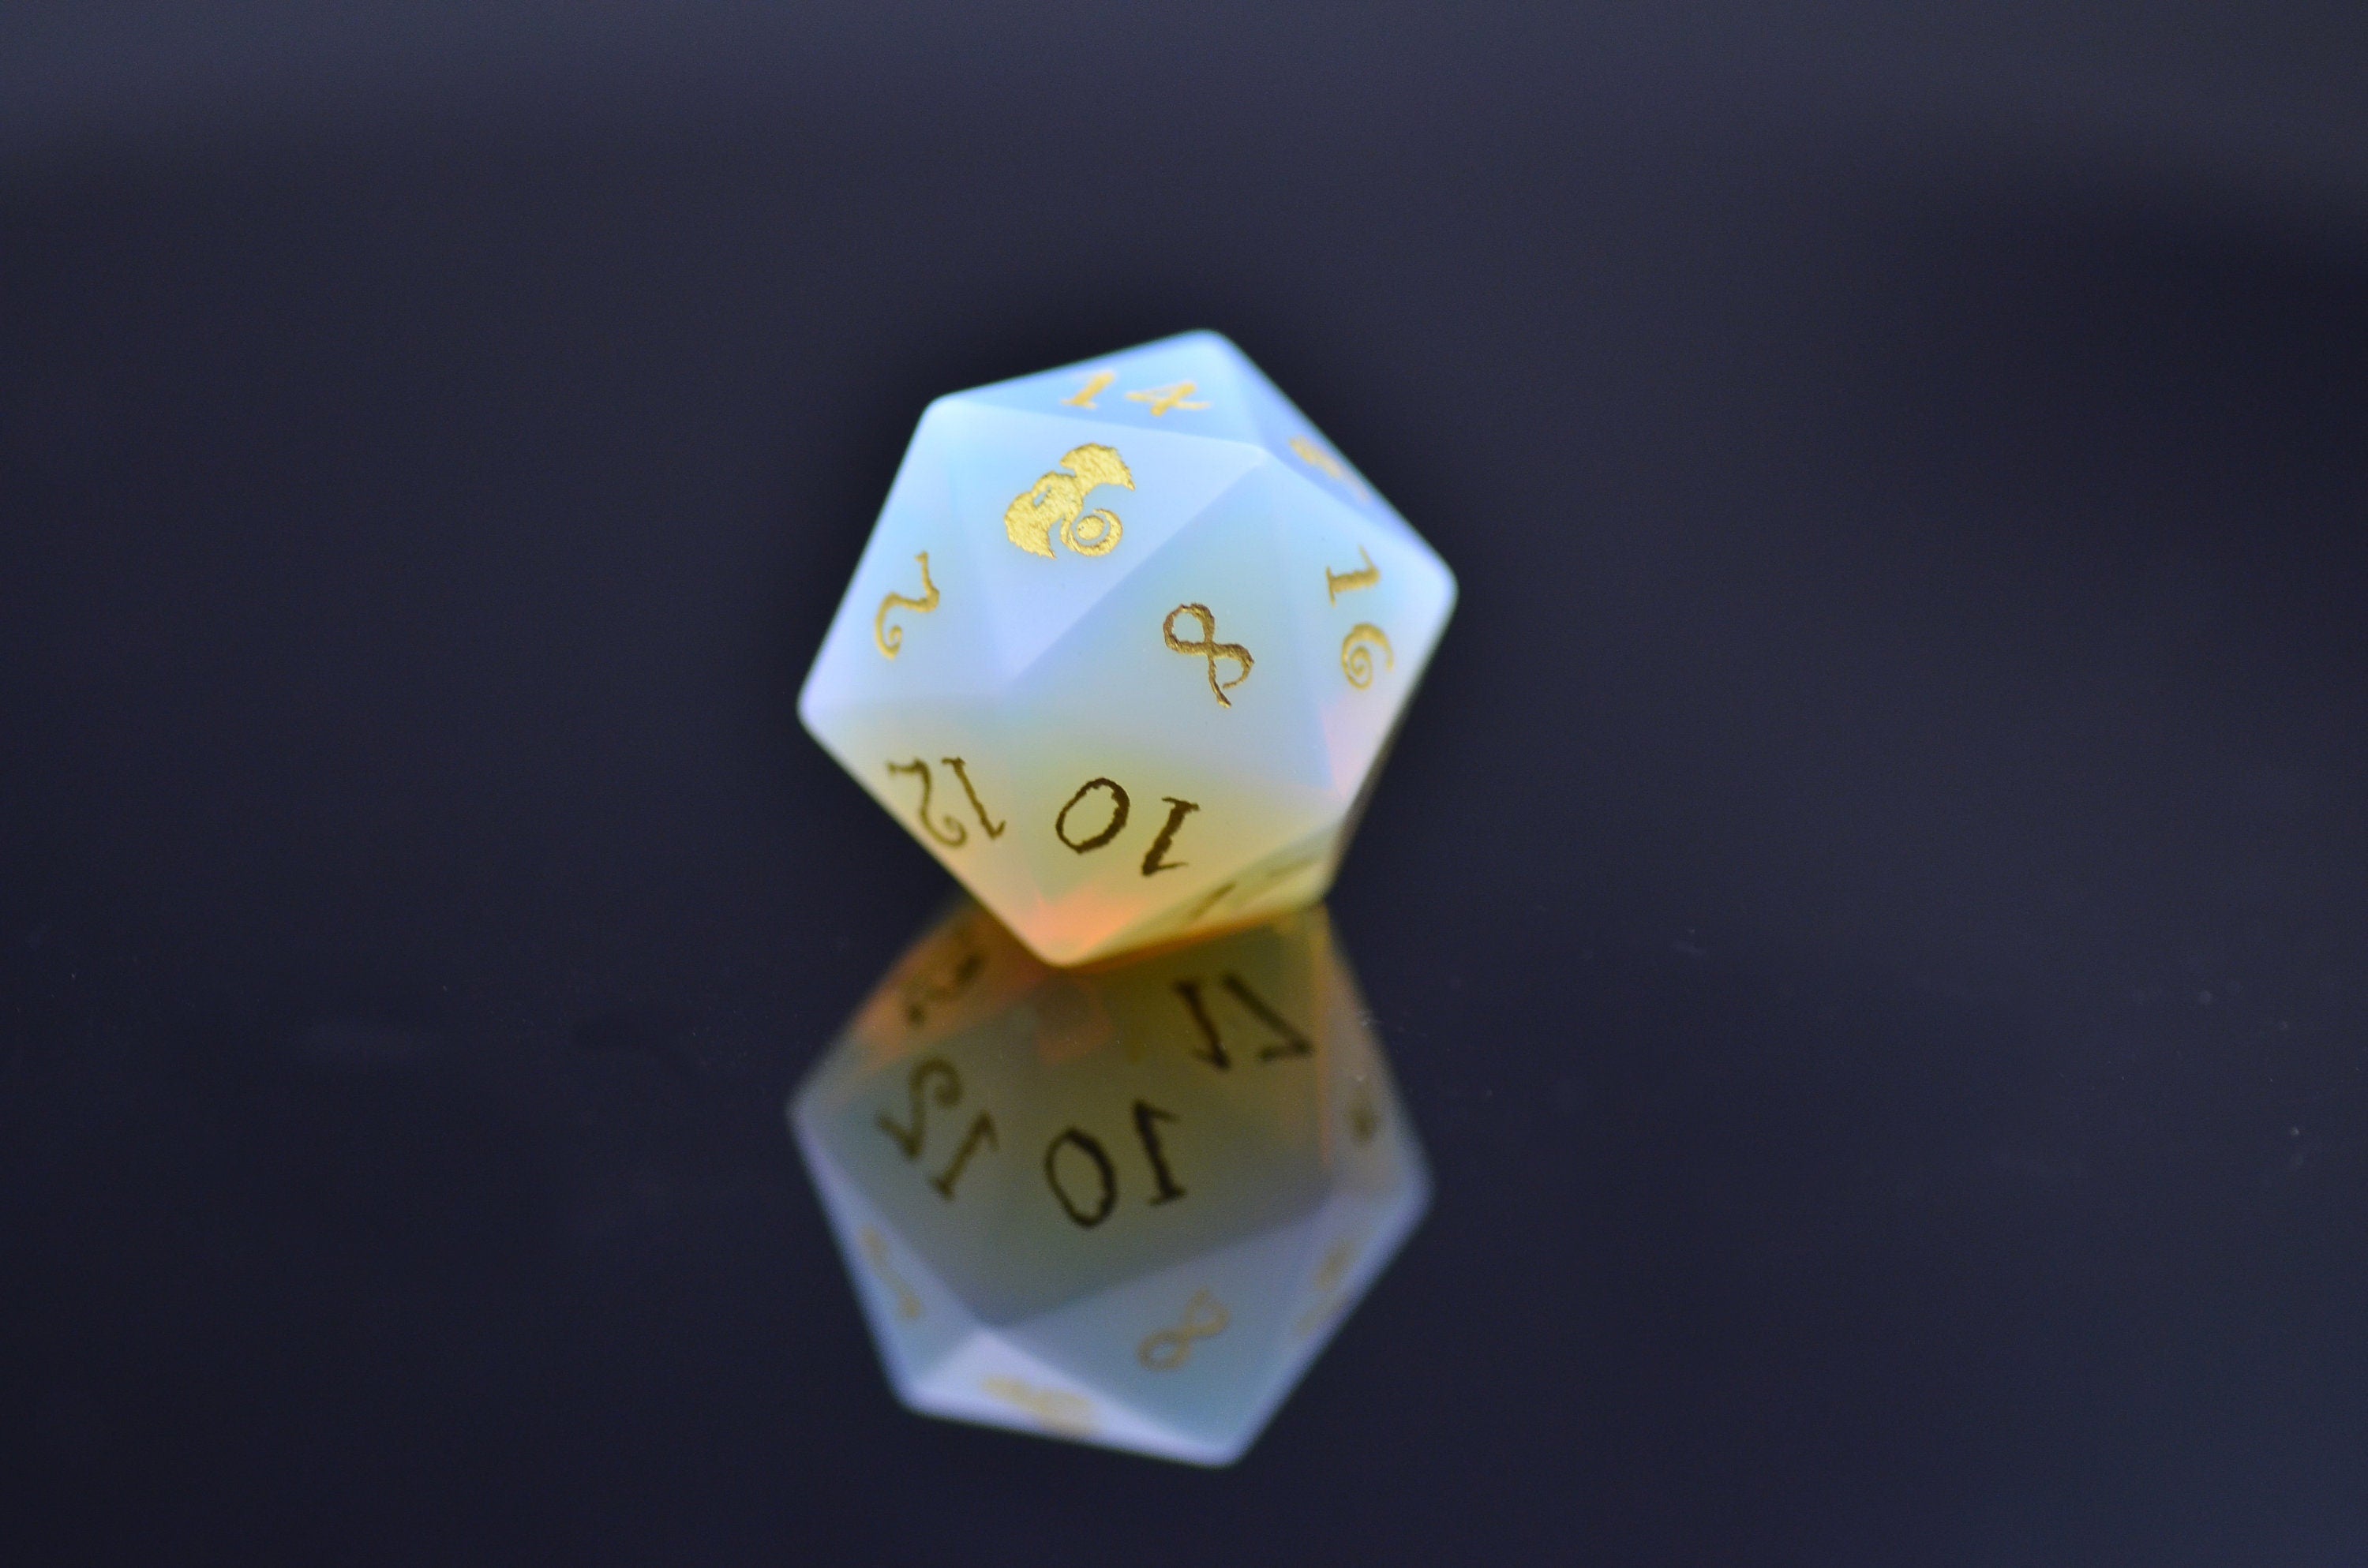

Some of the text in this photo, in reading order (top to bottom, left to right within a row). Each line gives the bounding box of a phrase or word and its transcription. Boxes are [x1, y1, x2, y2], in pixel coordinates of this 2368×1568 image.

[1061, 370, 1213, 416] 14
[1163, 602, 1254, 709] 8
[1325, 546, 1395, 690] 16
[886, 757, 1006, 848] 12
[1055, 777, 1200, 878] 10
